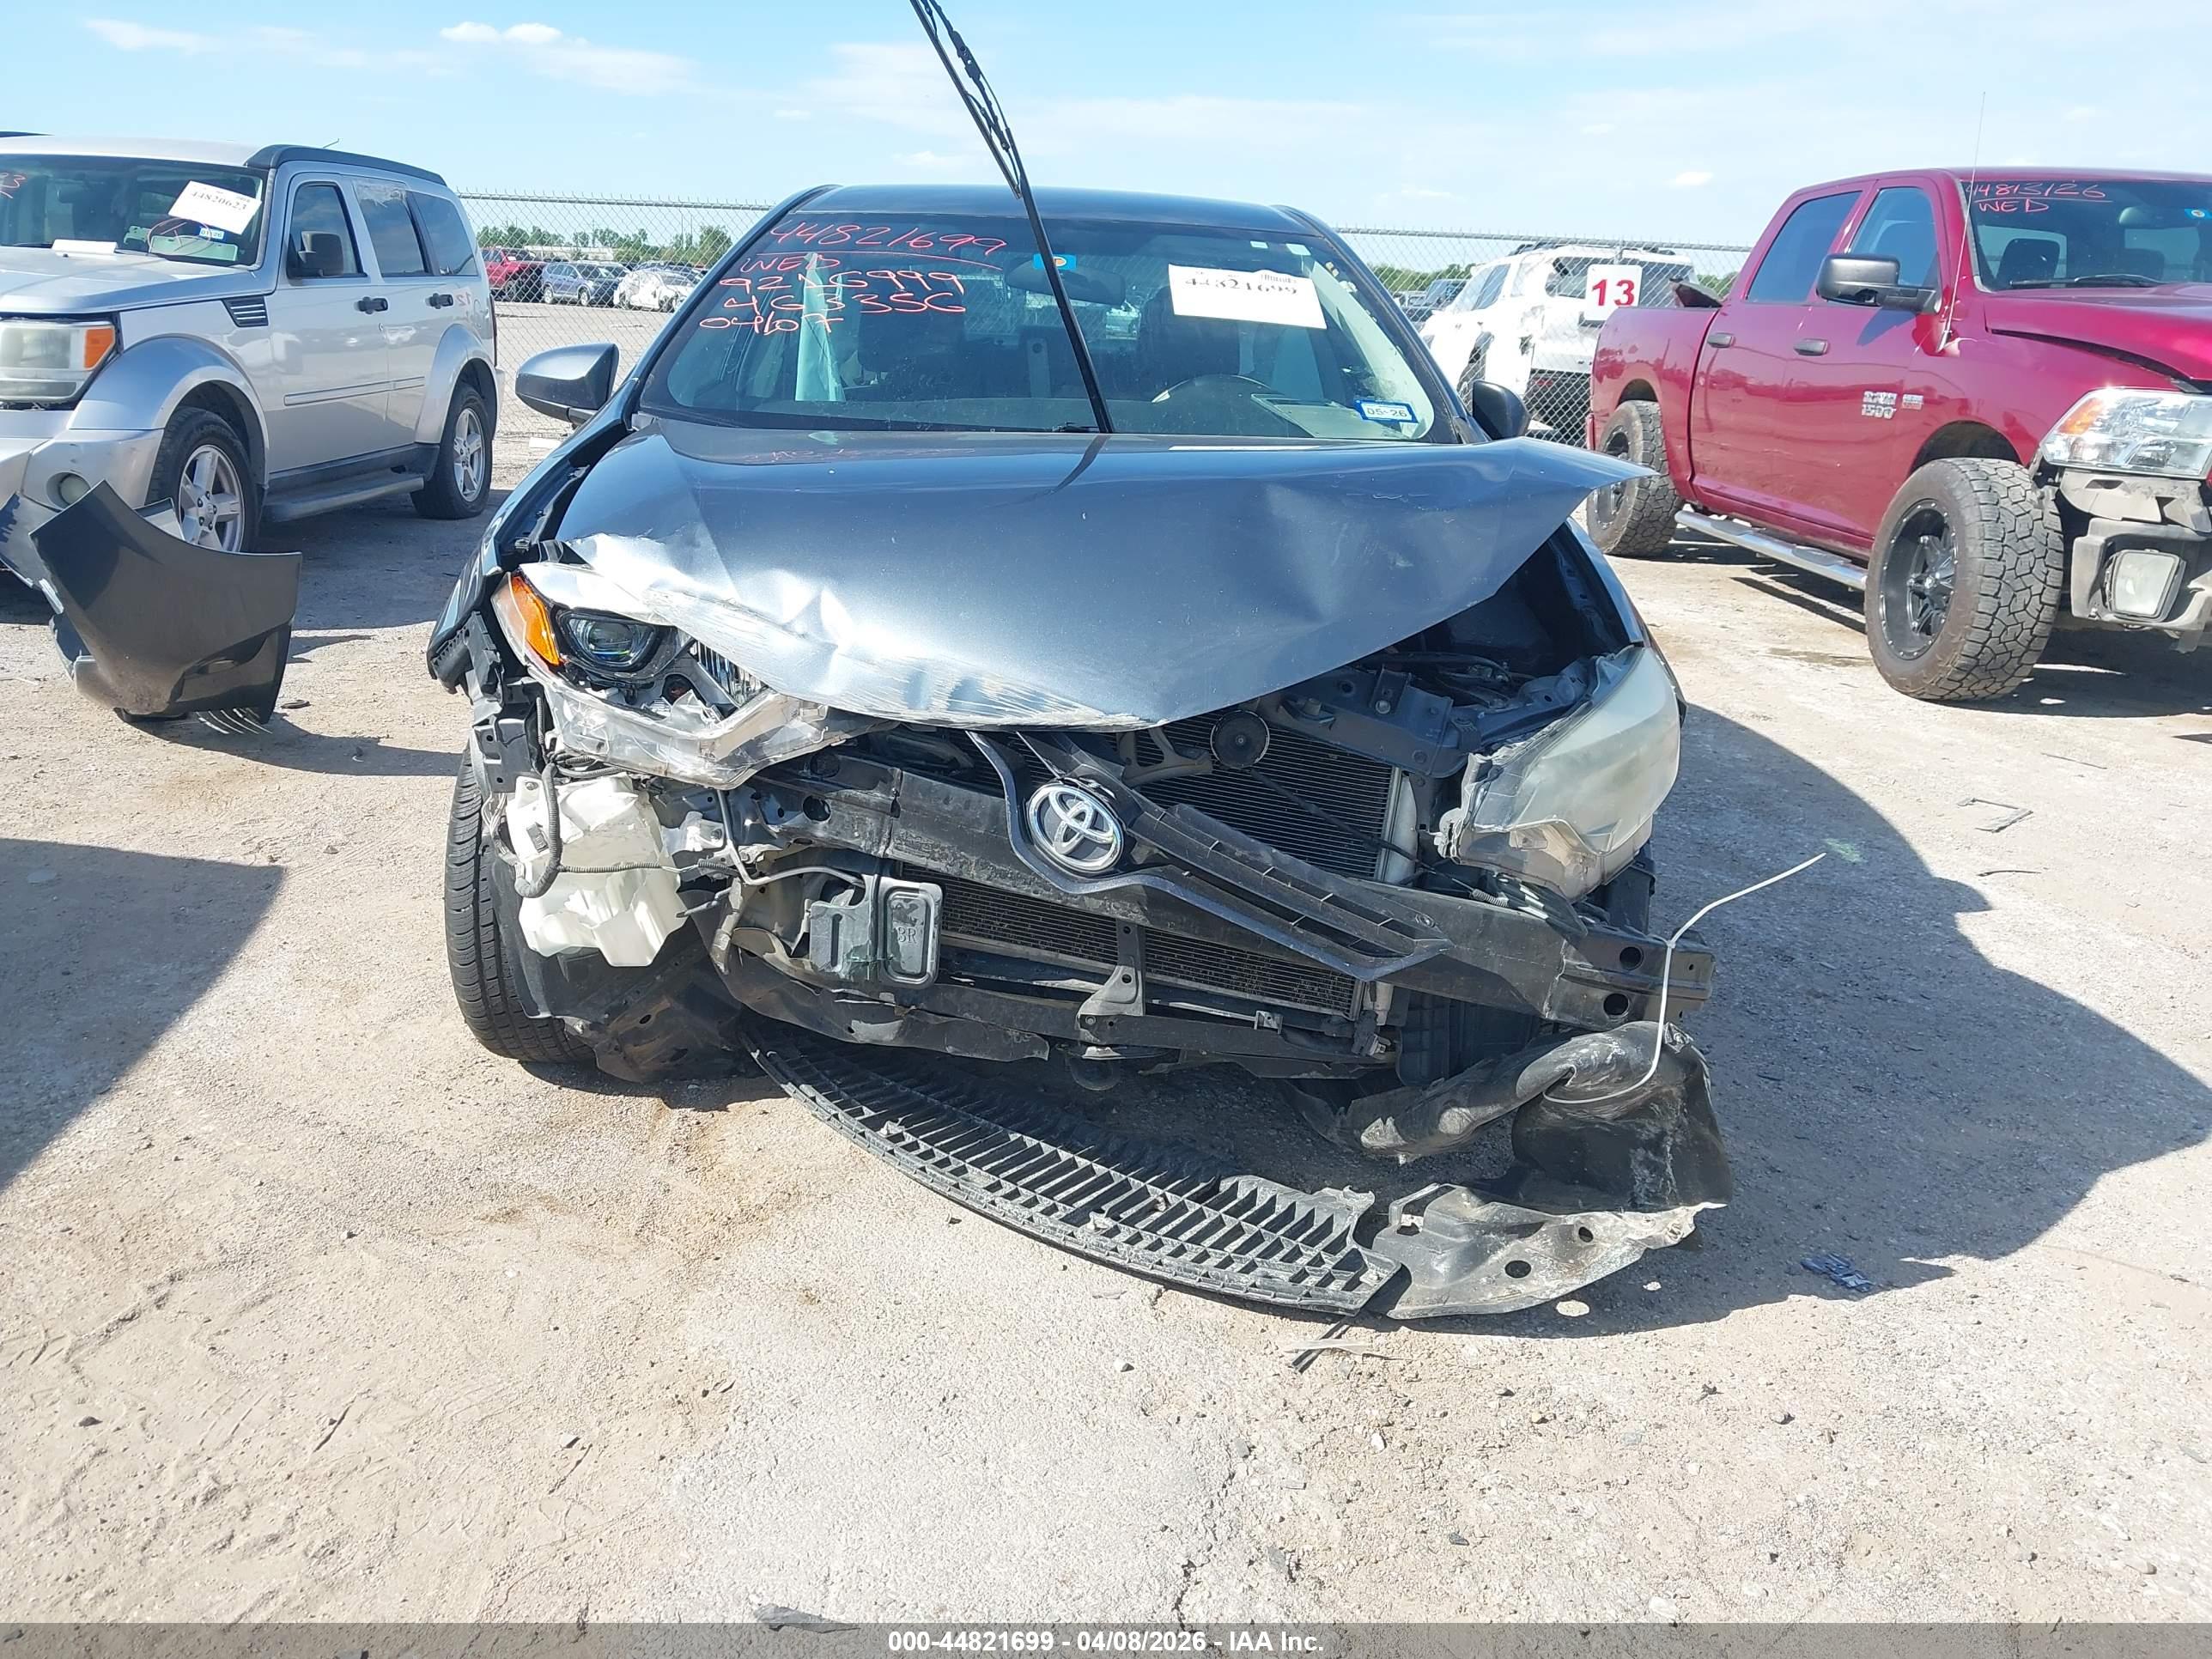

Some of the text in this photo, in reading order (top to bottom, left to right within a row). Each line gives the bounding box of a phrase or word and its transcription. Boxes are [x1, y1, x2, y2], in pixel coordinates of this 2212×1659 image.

[1979, 198, 2050, 214] WED
[770, 221, 1007, 256] 44821699
[740, 254, 841, 272] WED
[1592, 279, 1635, 307] 13
